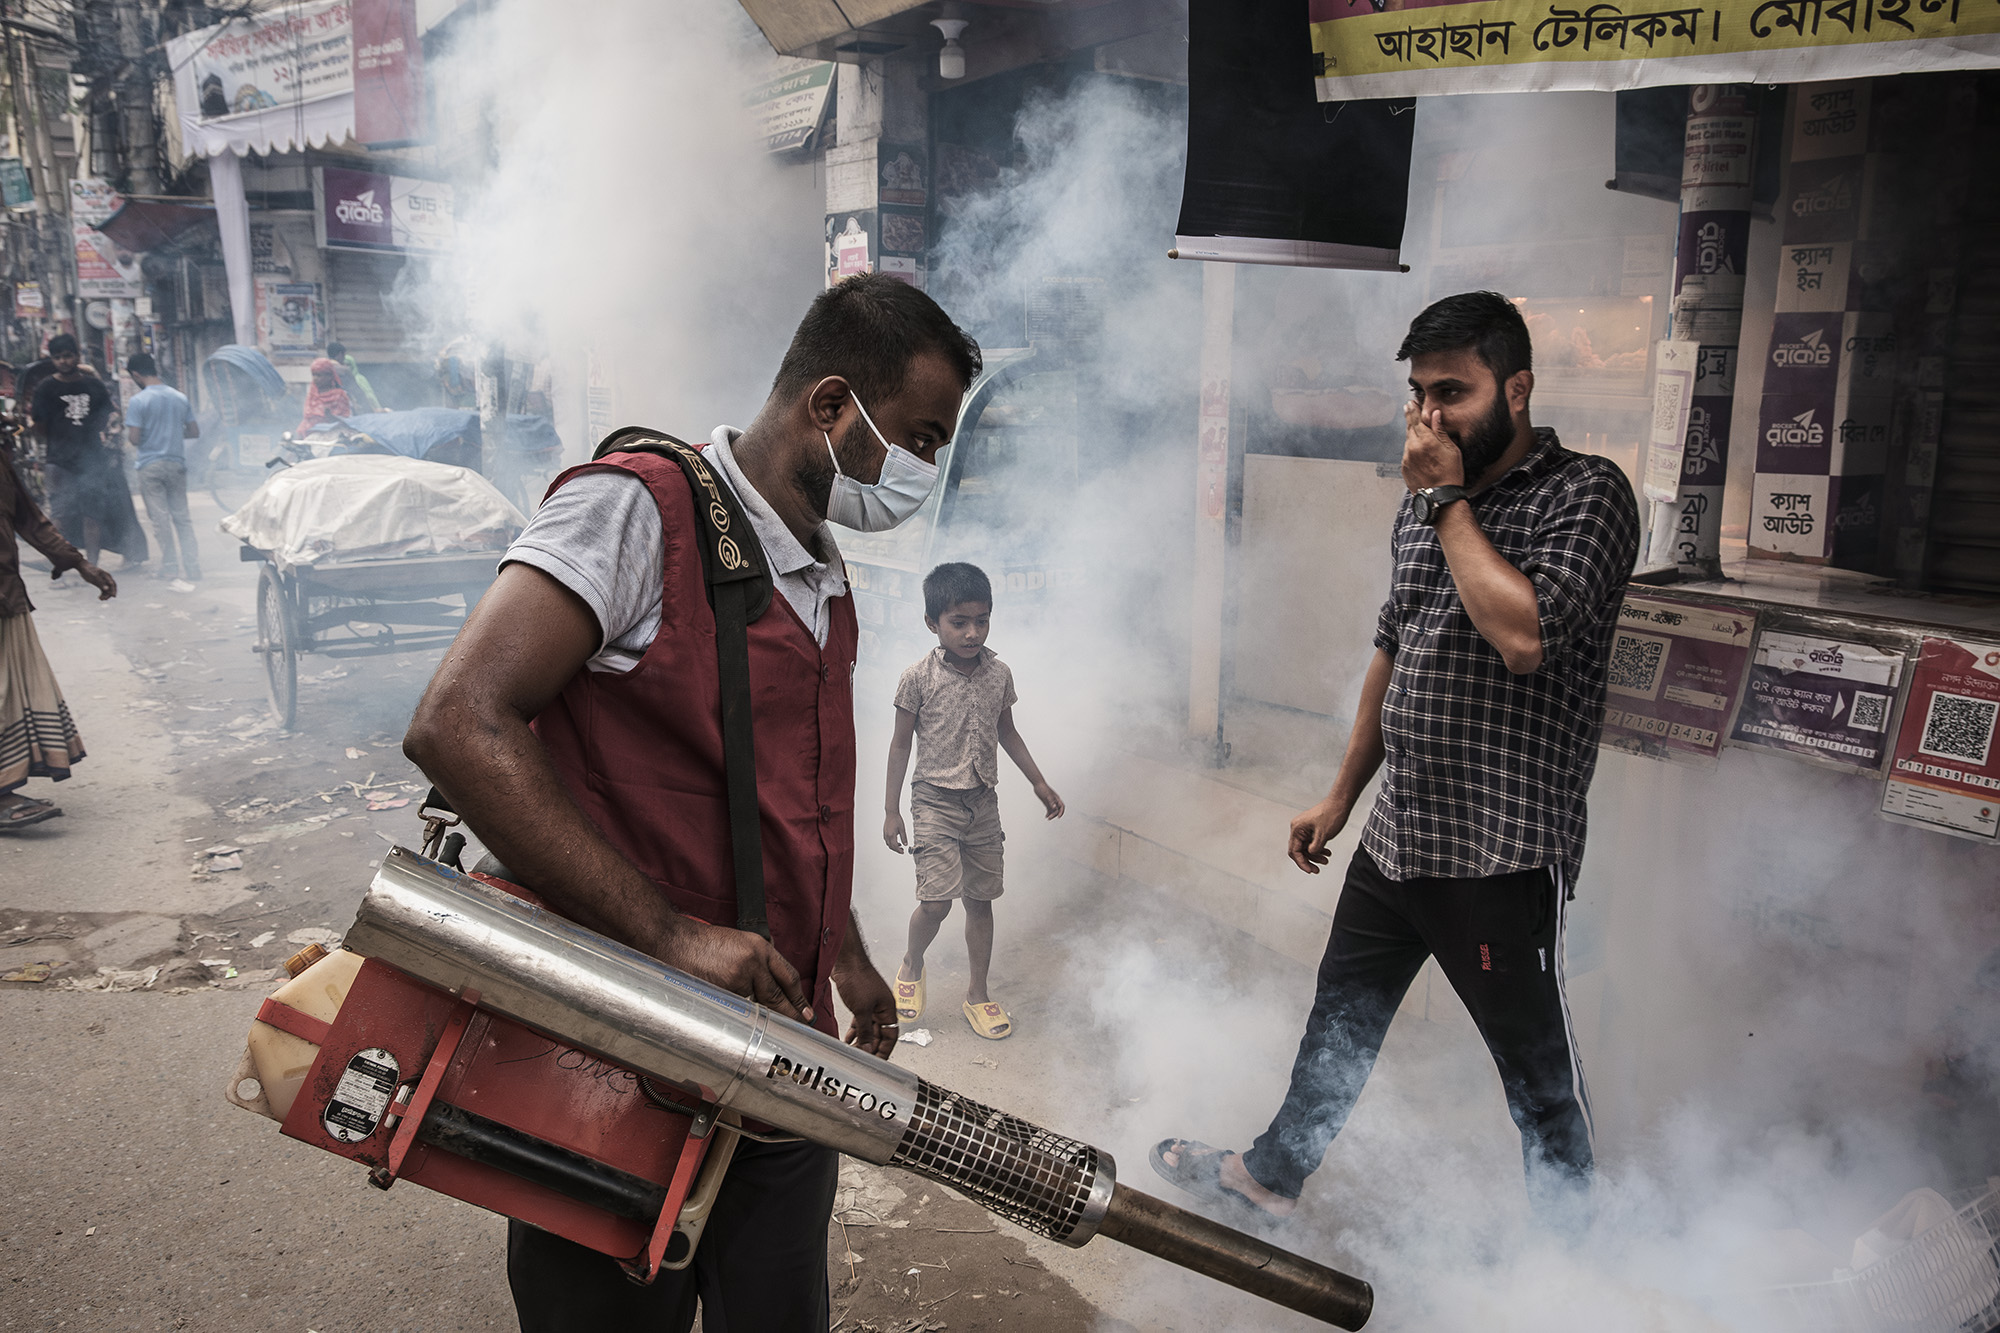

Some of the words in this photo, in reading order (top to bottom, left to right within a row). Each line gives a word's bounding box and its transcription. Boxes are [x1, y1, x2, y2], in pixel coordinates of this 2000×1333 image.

[1374, 18, 1517, 63] আহাছান
[1810, 88, 1855, 112] ক্যাশ
[1703, 130, 1722, 140] Call
[1724, 129, 1746, 140] Rate
[1803, 109, 1857, 137] আউট
[1701, 161, 1730, 173] airtel
[335, 203, 384, 224] রকেট
[1696, 222, 1720, 273] রকে
[1791, 246, 1834, 266] ক্যাশ
[1796, 268, 1823, 292] ইন
[1772, 343, 1832, 368] রকেট
[1684, 406, 1708, 475] রকেট
[1766, 423, 1825, 447] রকেট
[1839, 419, 1867, 443] বিল
[1680, 492, 1708, 536] বিল
[1770, 492, 1812, 512] ক্যাশ
[1763, 512, 1815, 536] আউট
[1677, 542, 1697, 567] পে
[1619, 604, 1650, 621] বিকাশ
[1710, 623, 1734, 634] bKash
[1809, 649, 1845, 666] রকেট
[1752, 680, 1769, 692] QR
[1793, 689, 1813, 700] স্ক্যান
[1941, 672, 1963, 685] নগদ
[1775, 695, 1800, 709] আউট
[1801, 702, 1825, 714] করুন
[1624, 715, 1665, 732] 7160
[1671, 725, 1714, 743] 3434
[766, 1053, 898, 1121] pulsFOG
